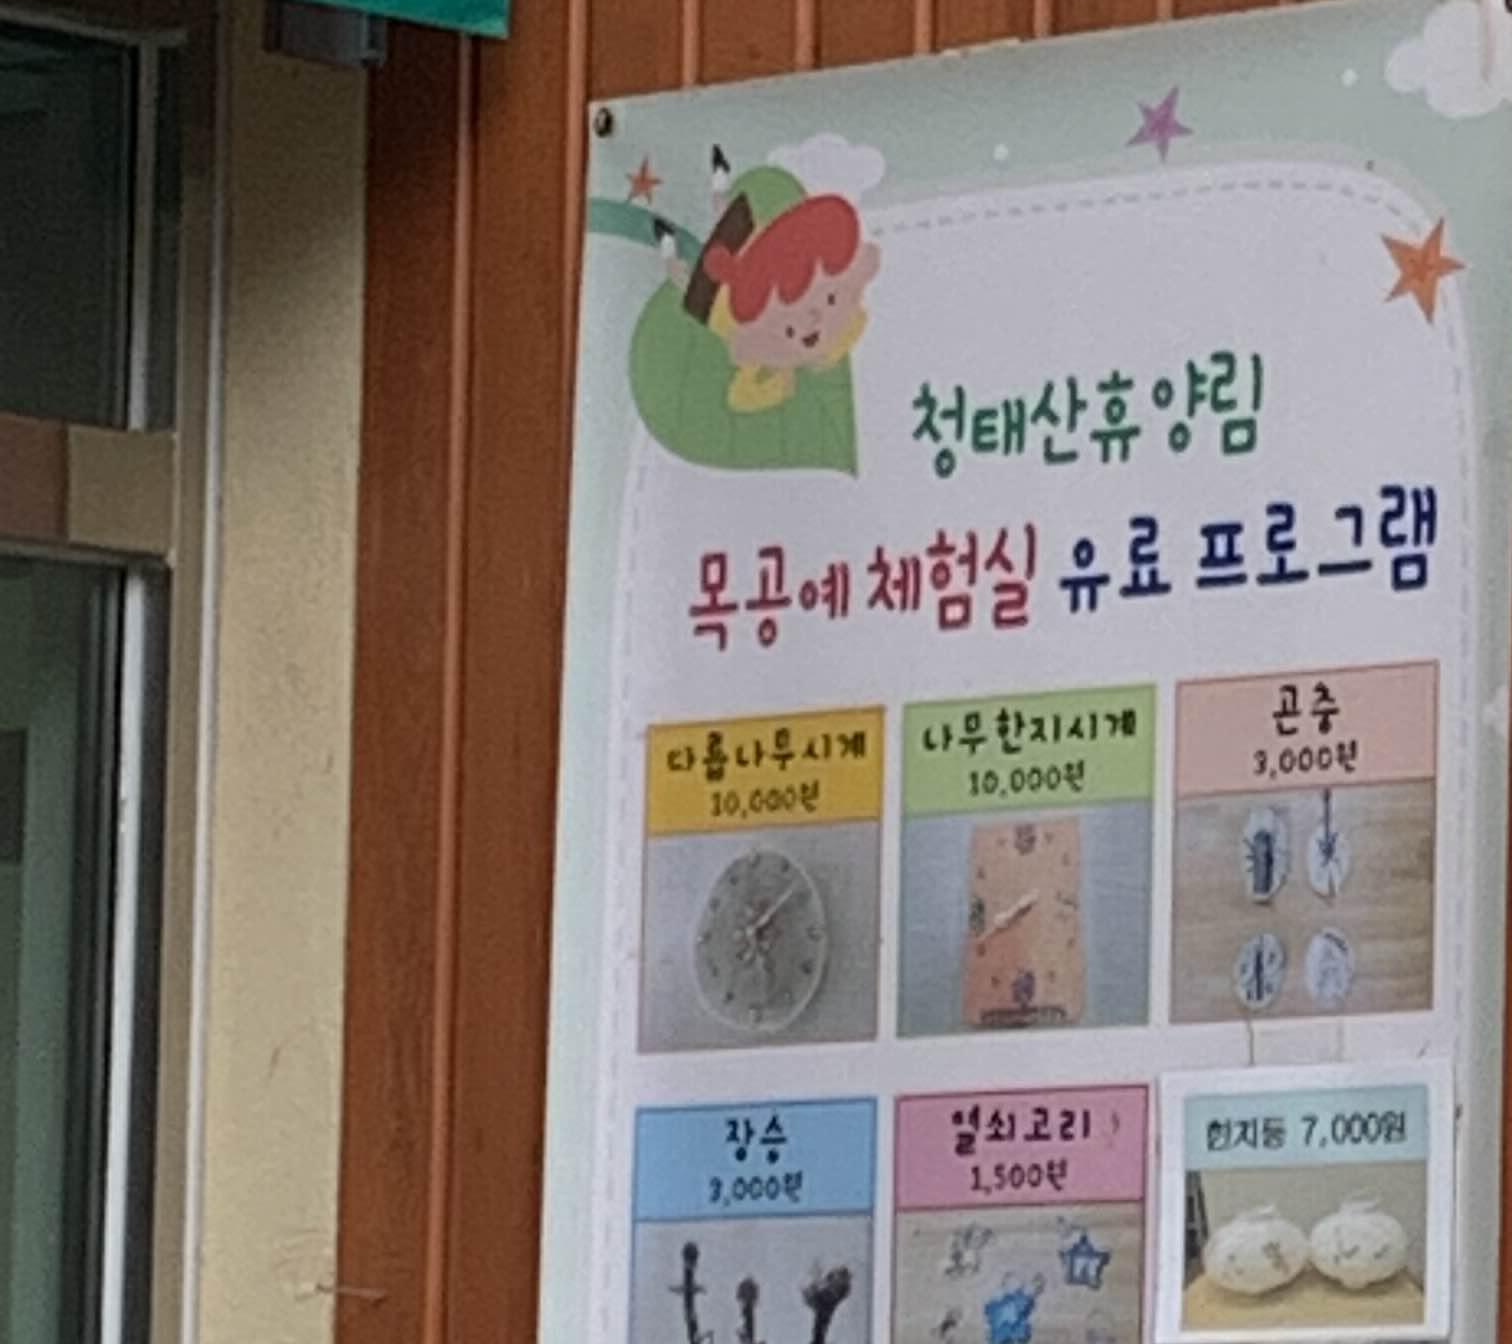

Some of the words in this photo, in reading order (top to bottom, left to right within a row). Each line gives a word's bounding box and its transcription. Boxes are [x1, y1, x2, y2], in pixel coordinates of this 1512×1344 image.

[911, 351, 1264, 479] 청태산휴양림
[1058, 515, 1172, 614] 유료
[1195, 484, 1438, 592] 프로그램
[1272, 681, 1340, 736] 곤충
[969, 759, 1085, 796] 10,000원
[1254, 739, 1358, 779] 3,000원
[725, 1113, 788, 1165] 장승
[951, 1103, 1091, 1157] 열쇠고리
[1301, 1109, 1407, 1149] 7,000원
